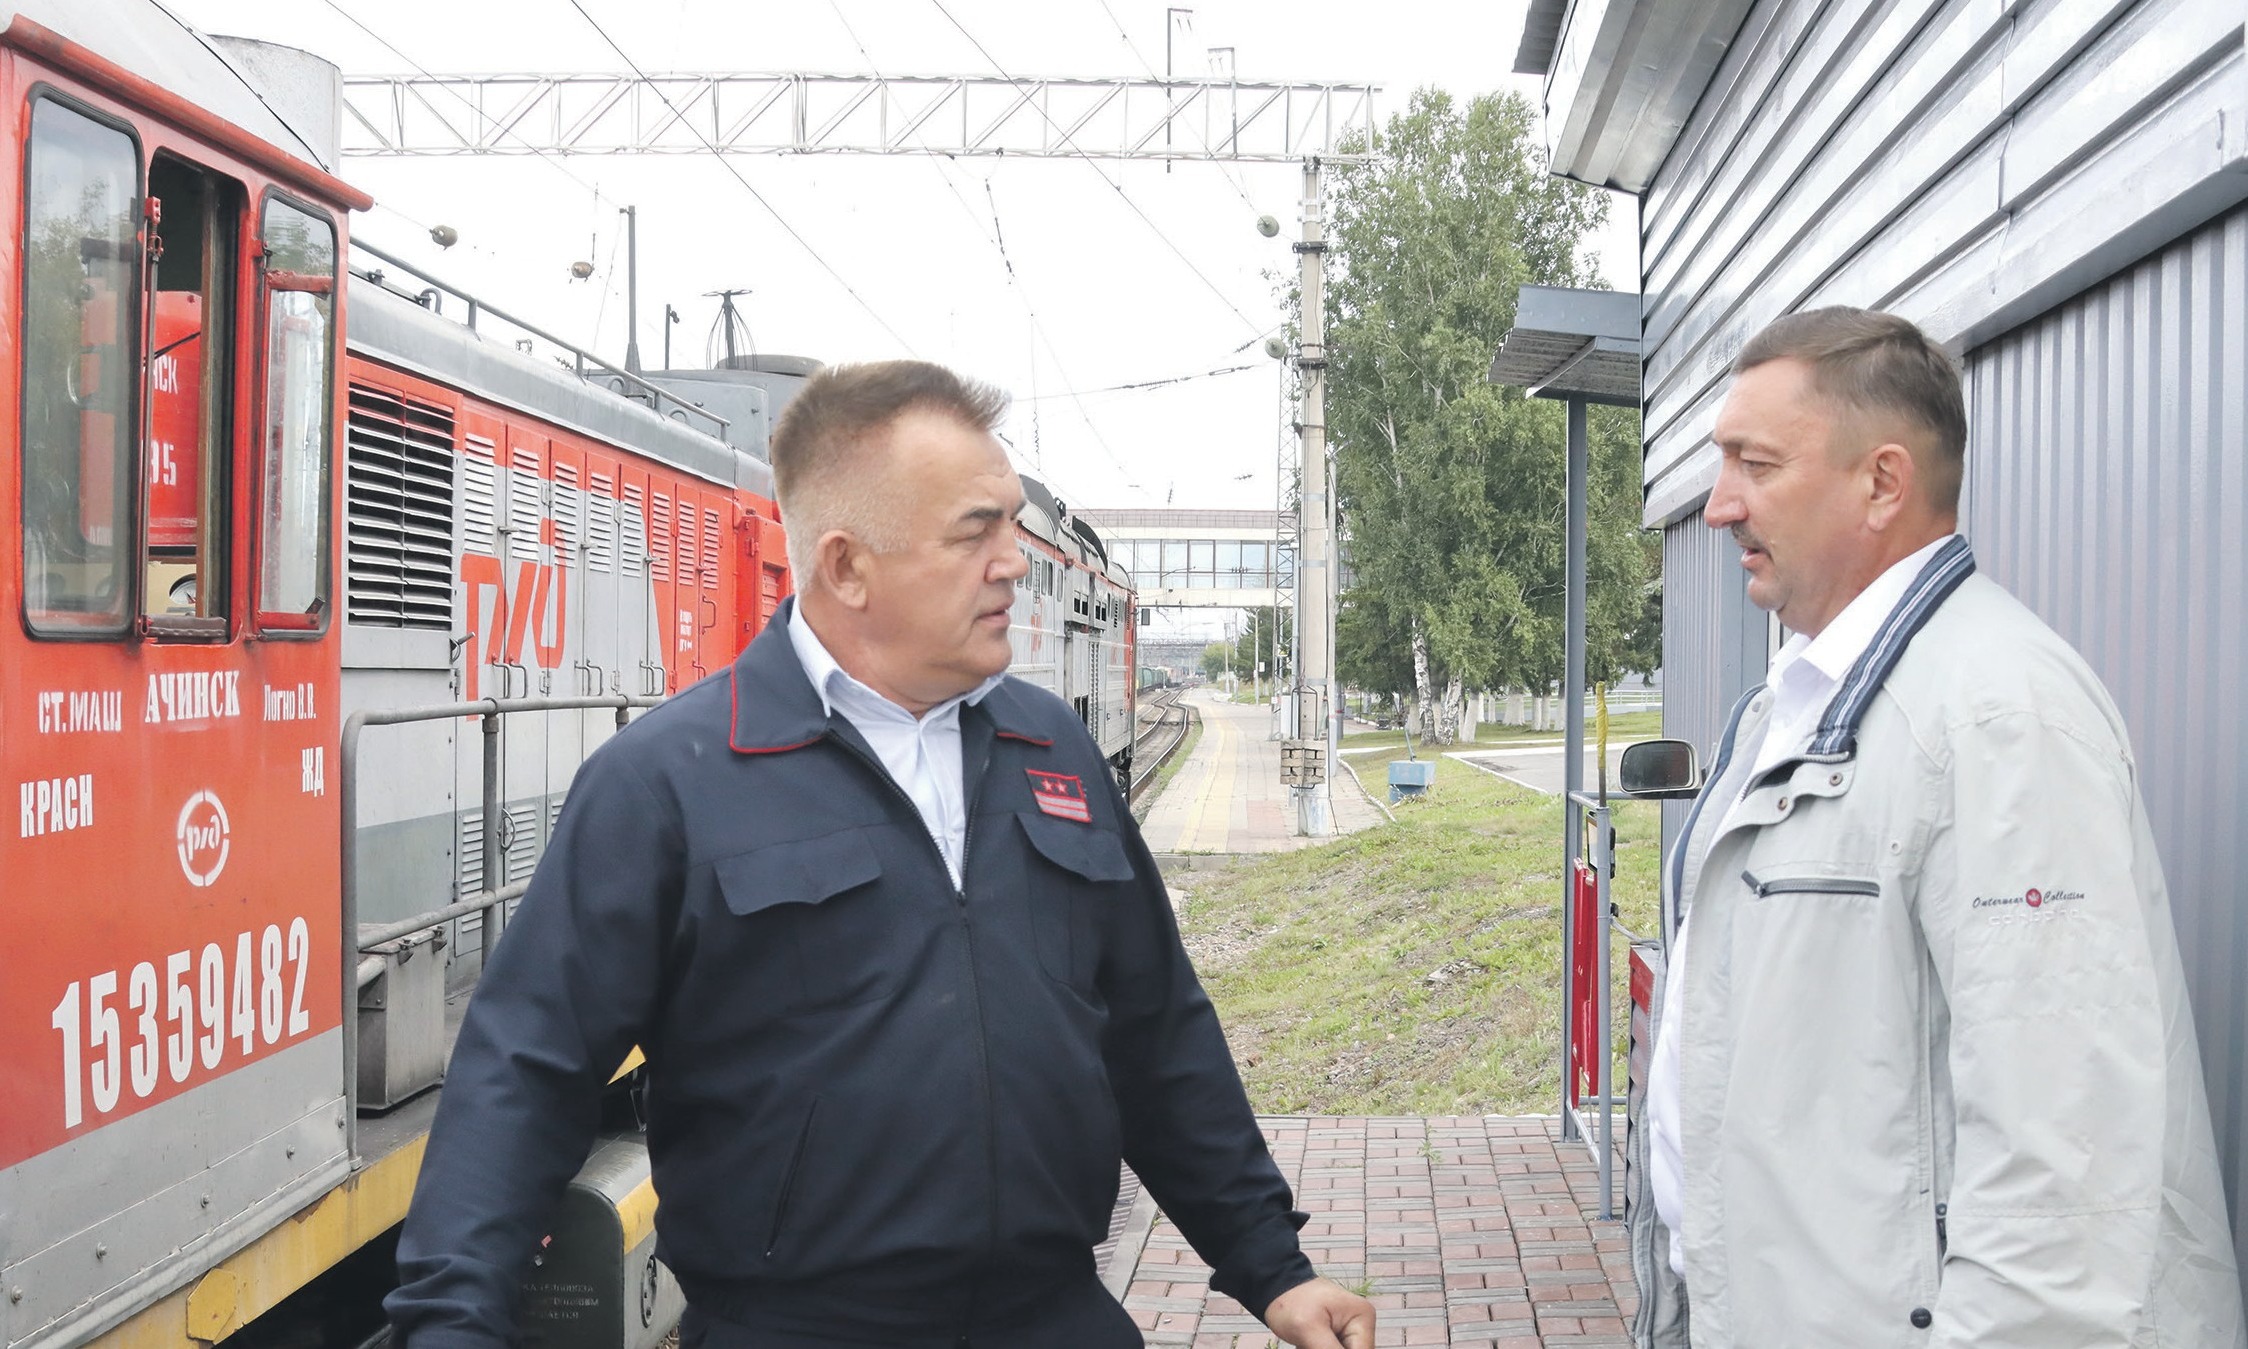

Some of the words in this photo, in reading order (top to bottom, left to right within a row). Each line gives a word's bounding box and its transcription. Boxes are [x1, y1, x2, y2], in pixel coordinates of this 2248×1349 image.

[145, 670, 240, 723] АЧИНСК
[302, 746, 324, 797] ЖД
[20, 774, 93, 838] КРАСН
[1972, 897, 2024, 908] Outerwear
[52, 916, 309, 1129] 15359482
